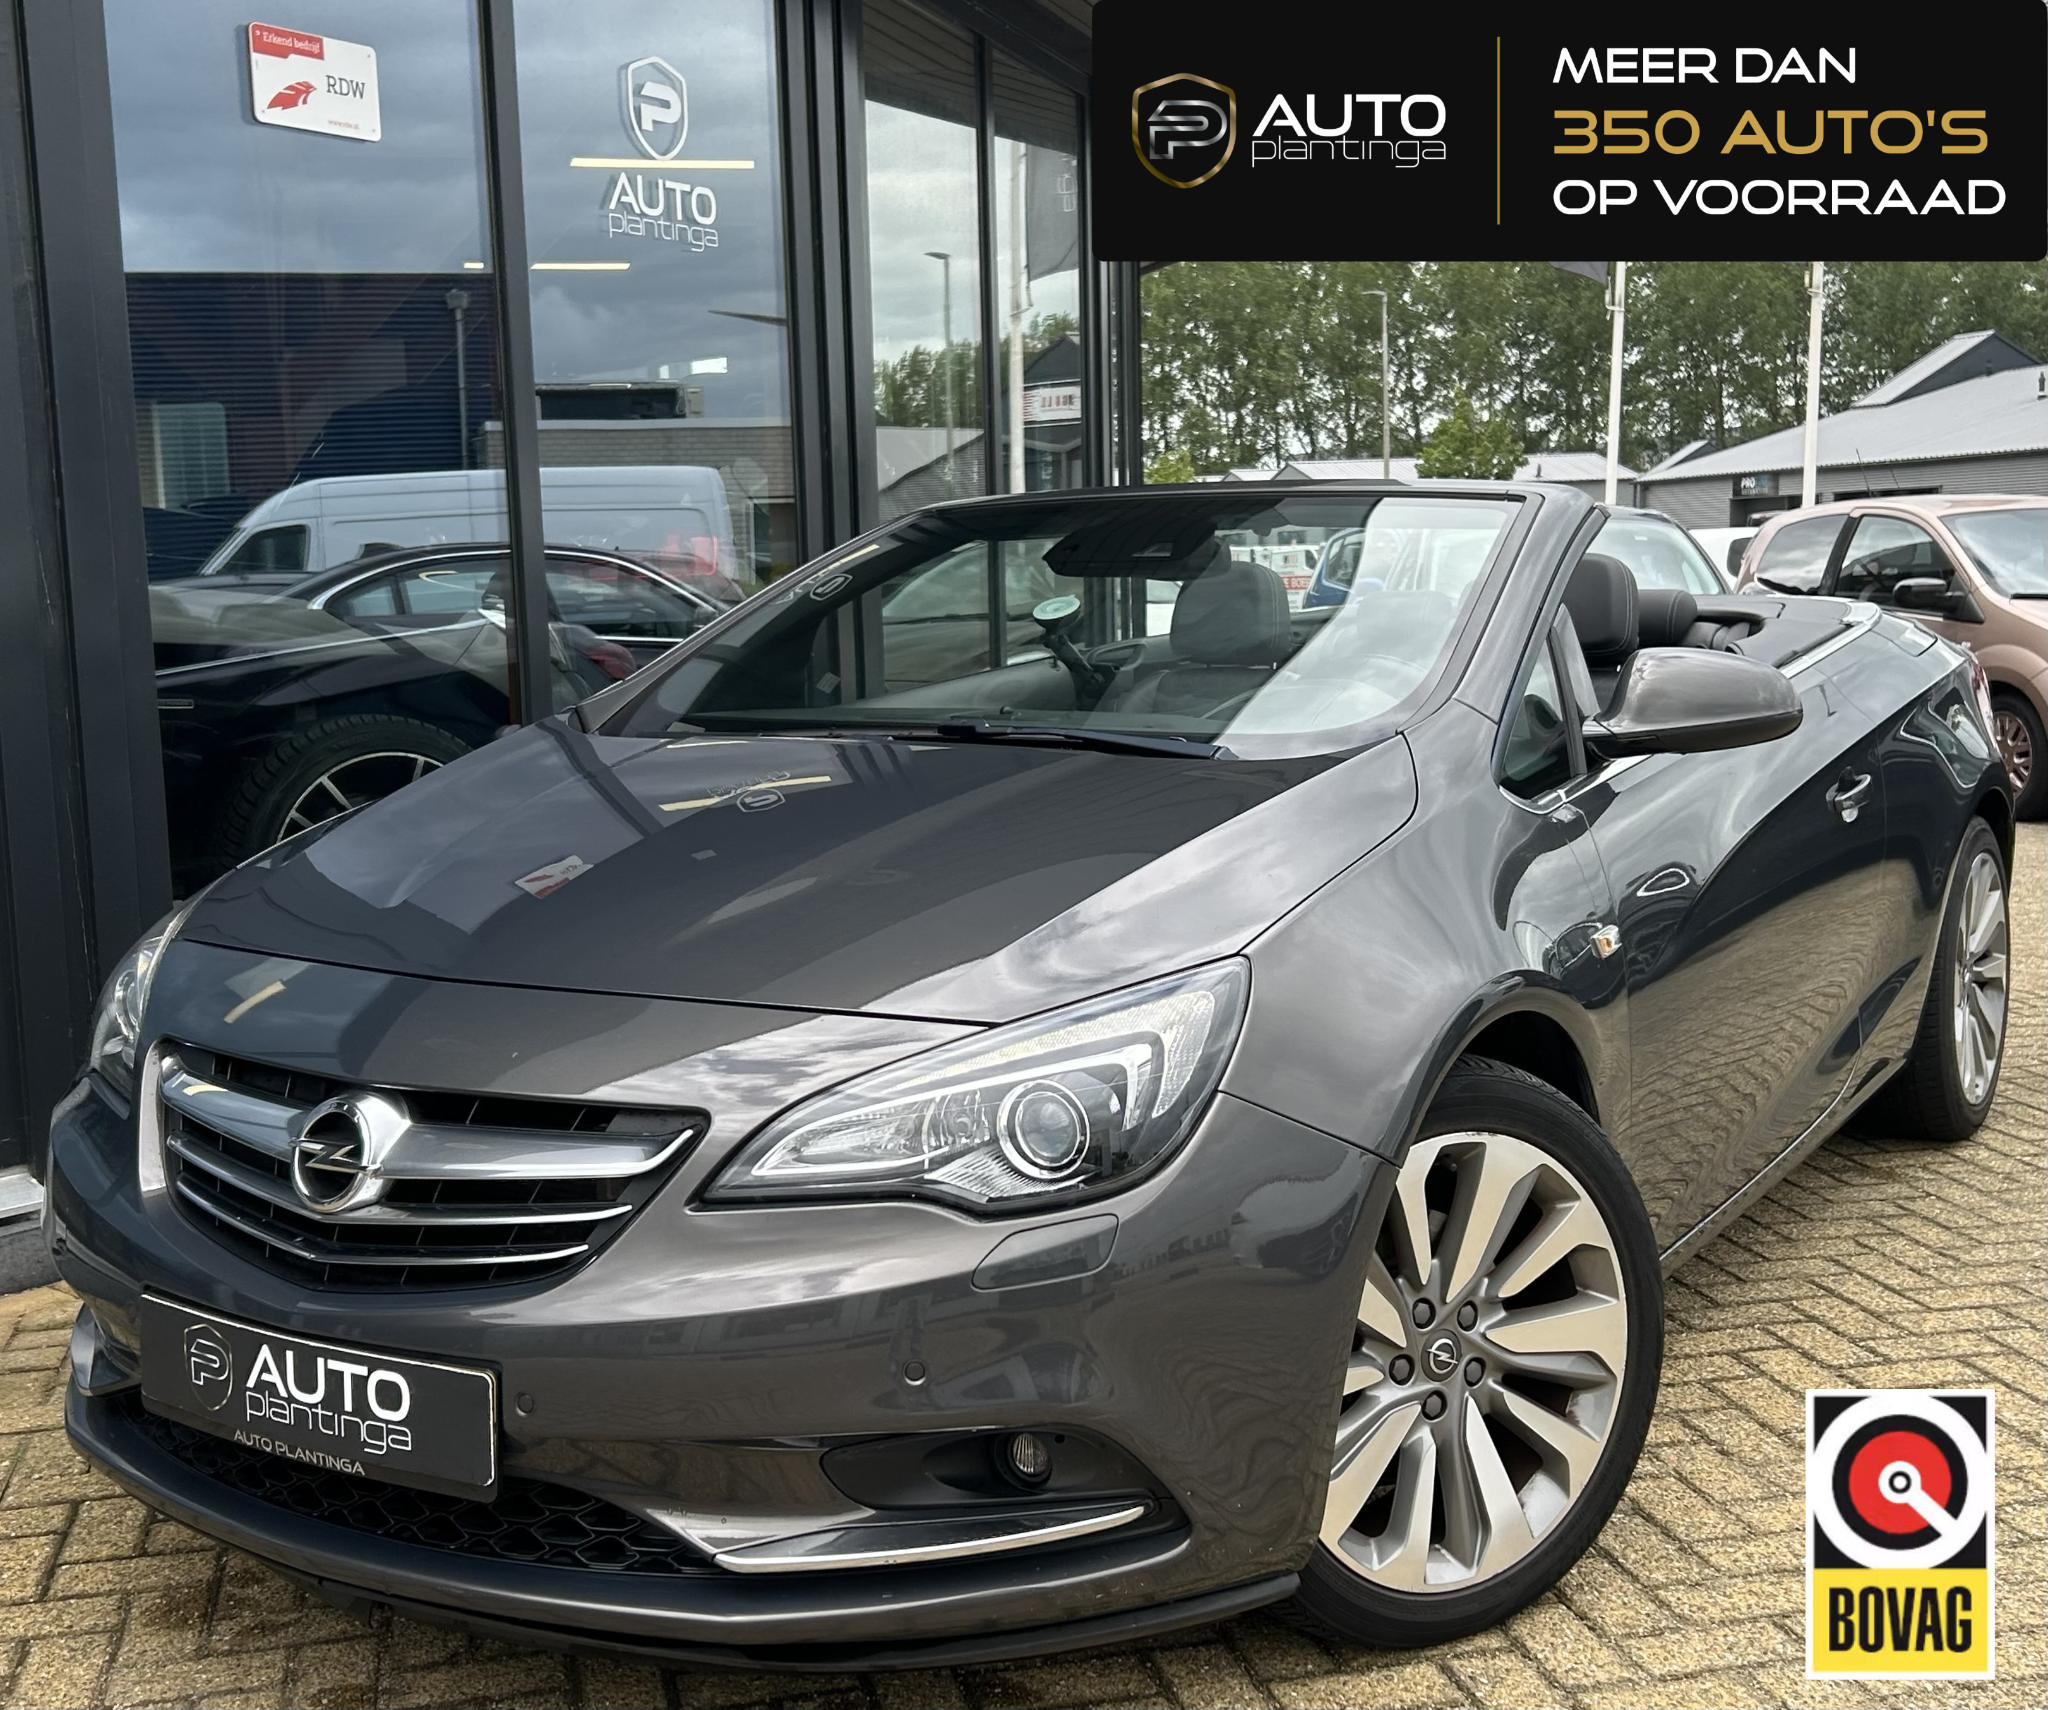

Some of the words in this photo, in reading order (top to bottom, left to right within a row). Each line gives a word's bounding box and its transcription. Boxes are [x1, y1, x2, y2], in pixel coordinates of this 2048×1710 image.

[263, 31, 293, 47] Erkend
[326, 74, 366, 99] RDW
[609, 172, 717, 225] AUTO
[608, 211, 719, 252] plantinga
[246, 1344, 411, 1422] AUTO
[246, 1390, 412, 1454] plantinga
[234, 1429, 273, 1452] AUTO
[275, 1441, 366, 1476] PLANTINGA
